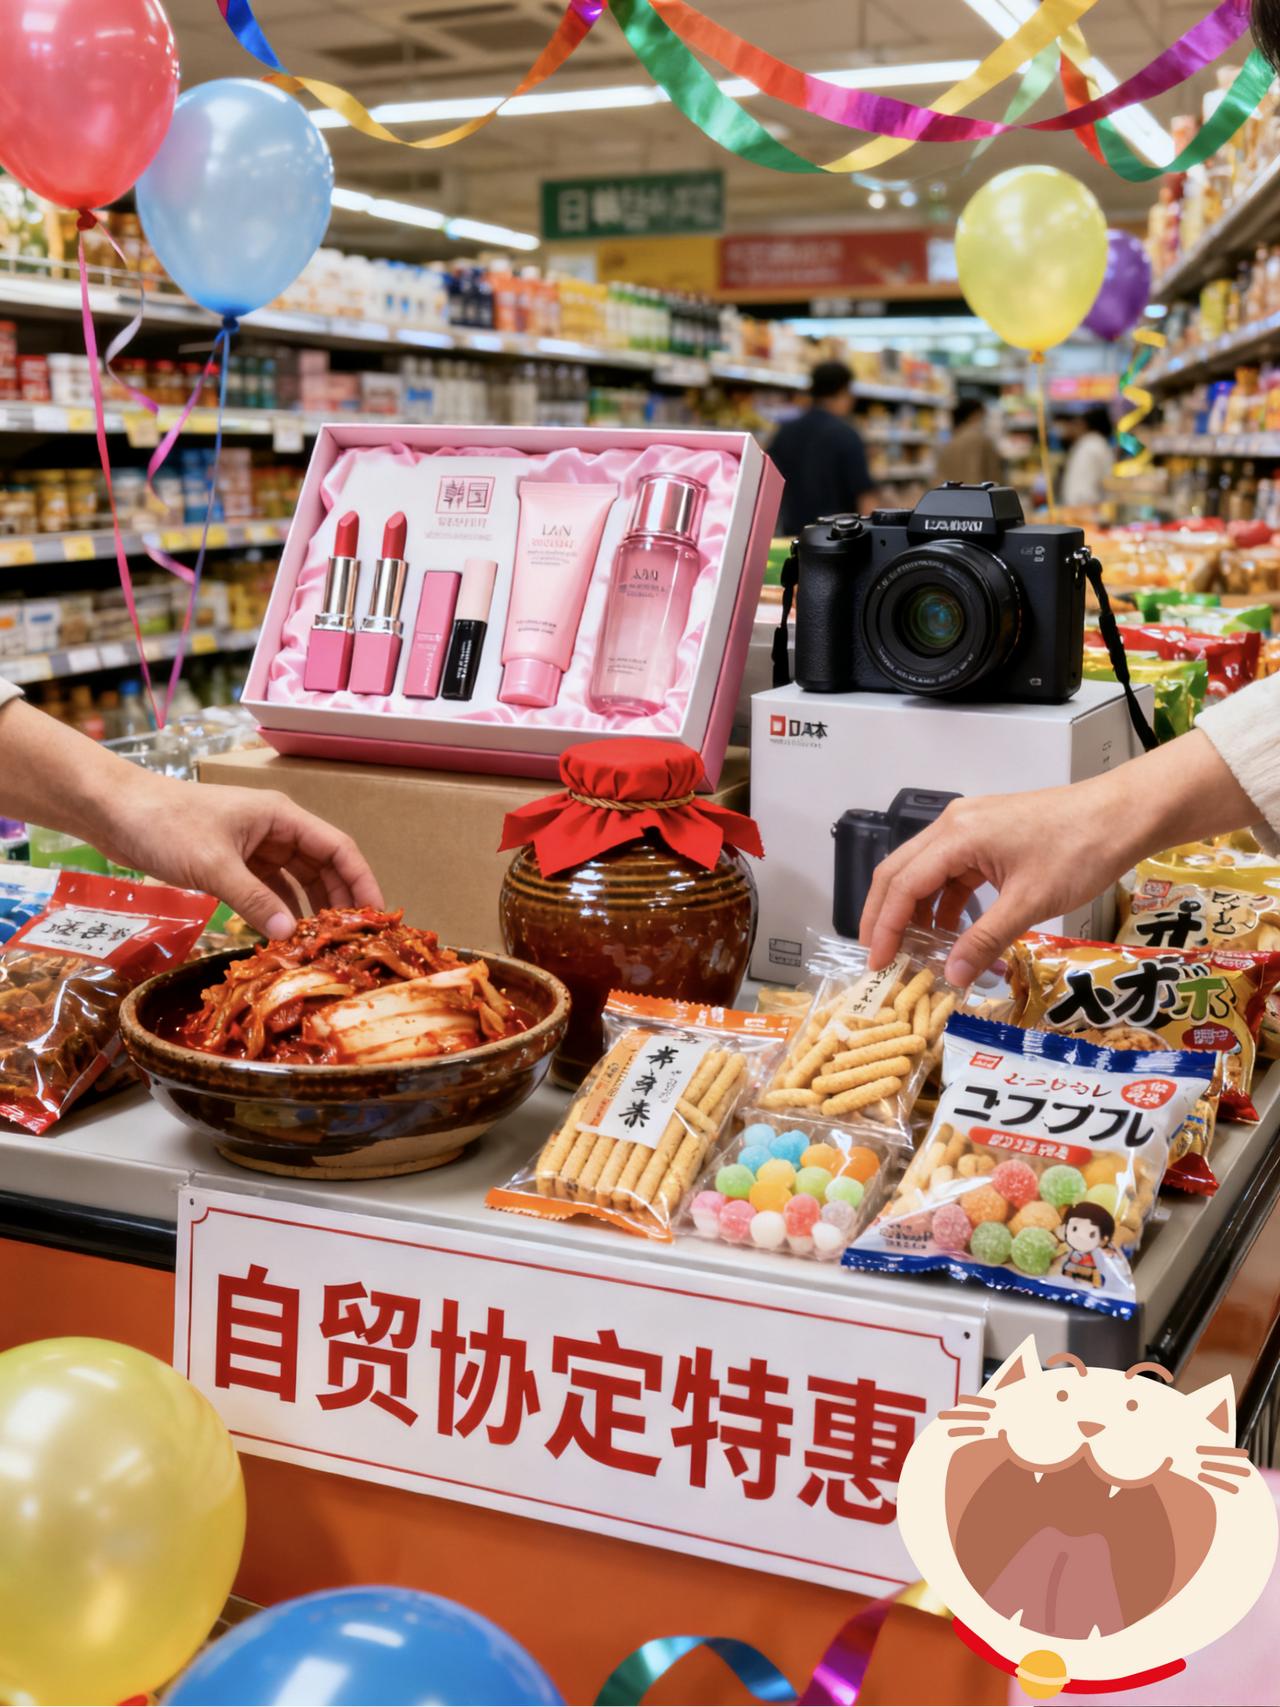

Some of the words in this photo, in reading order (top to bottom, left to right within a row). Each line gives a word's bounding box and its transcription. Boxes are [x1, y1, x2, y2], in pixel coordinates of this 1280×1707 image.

[214, 1263, 928, 1527] 自贸协定特惠
